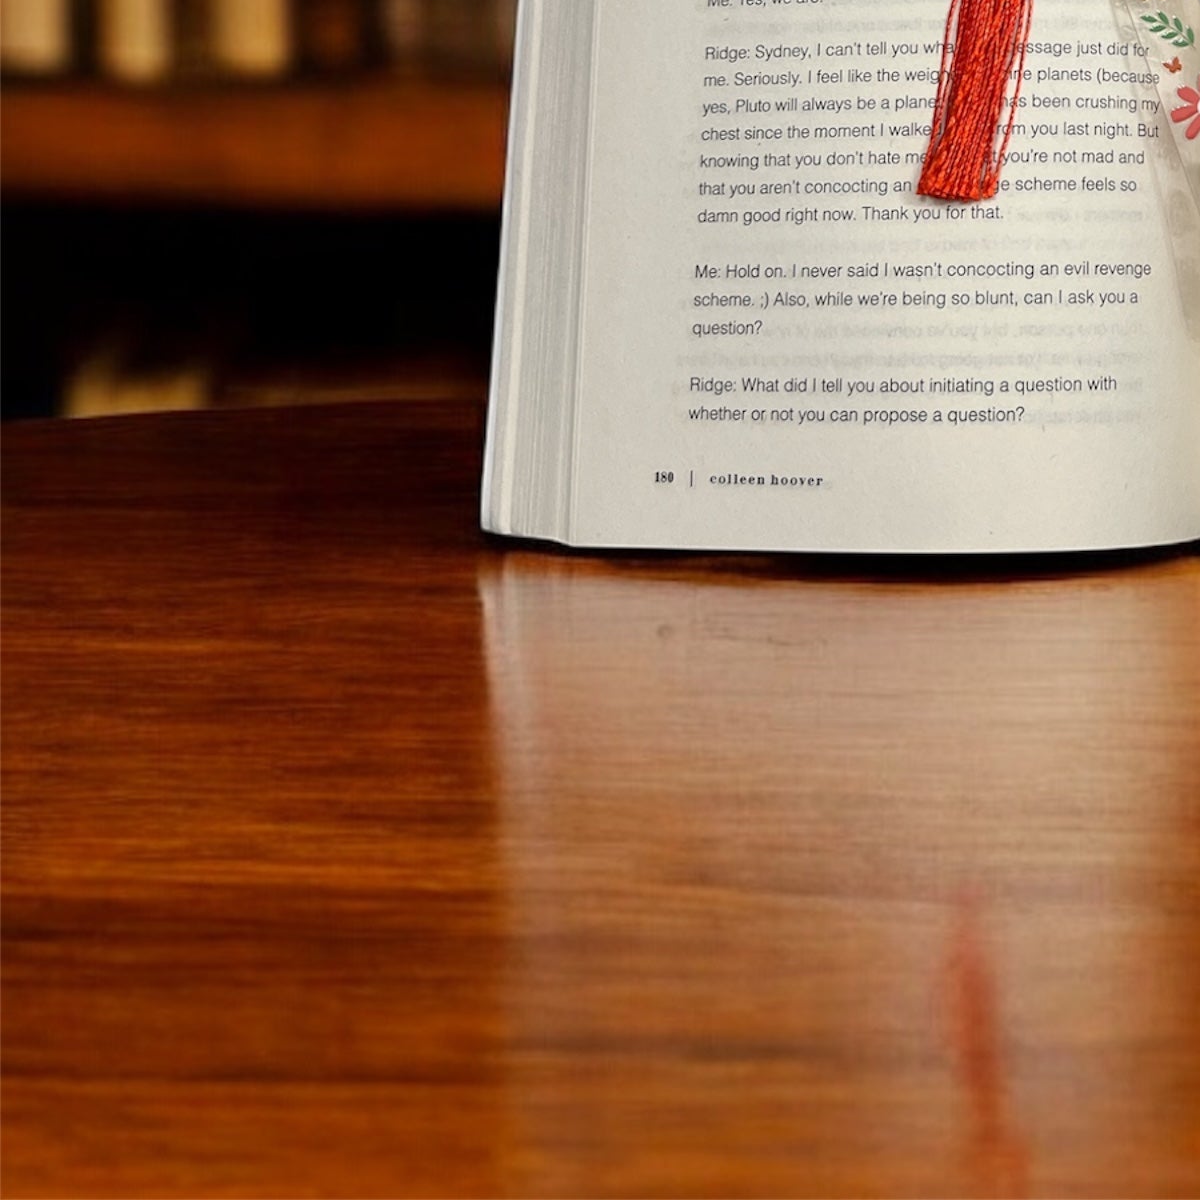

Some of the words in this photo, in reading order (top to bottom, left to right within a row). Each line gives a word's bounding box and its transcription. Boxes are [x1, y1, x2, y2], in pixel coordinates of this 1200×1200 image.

[697, 208, 738, 224] damn
[743, 207, 781, 227] good
[785, 207, 818, 226] right
[823, 210, 856, 222] now.
[862, 206, 909, 220] Thank
[913, 208, 941, 224] you
[946, 205, 966, 220] for
[971, 205, 1004, 220] that.
[695, 264, 721, 279] Me:
[726, 263, 760, 279] Hold
[764, 267, 787, 279] on.
[801, 266, 843, 279] never
[847, 262, 879, 279] said
[893, 261, 942, 278] wasn't
[947, 261, 1034, 280] concocting
[1040, 264, 1059, 277] an
[1064, 260, 1089, 276] evil
[1094, 263, 1151, 279] revenge
[692, 319, 763, 338] question?
[655, 471, 674, 484] 180
[710, 473, 765, 486] colleen
[770, 473, 823, 488] hoover
